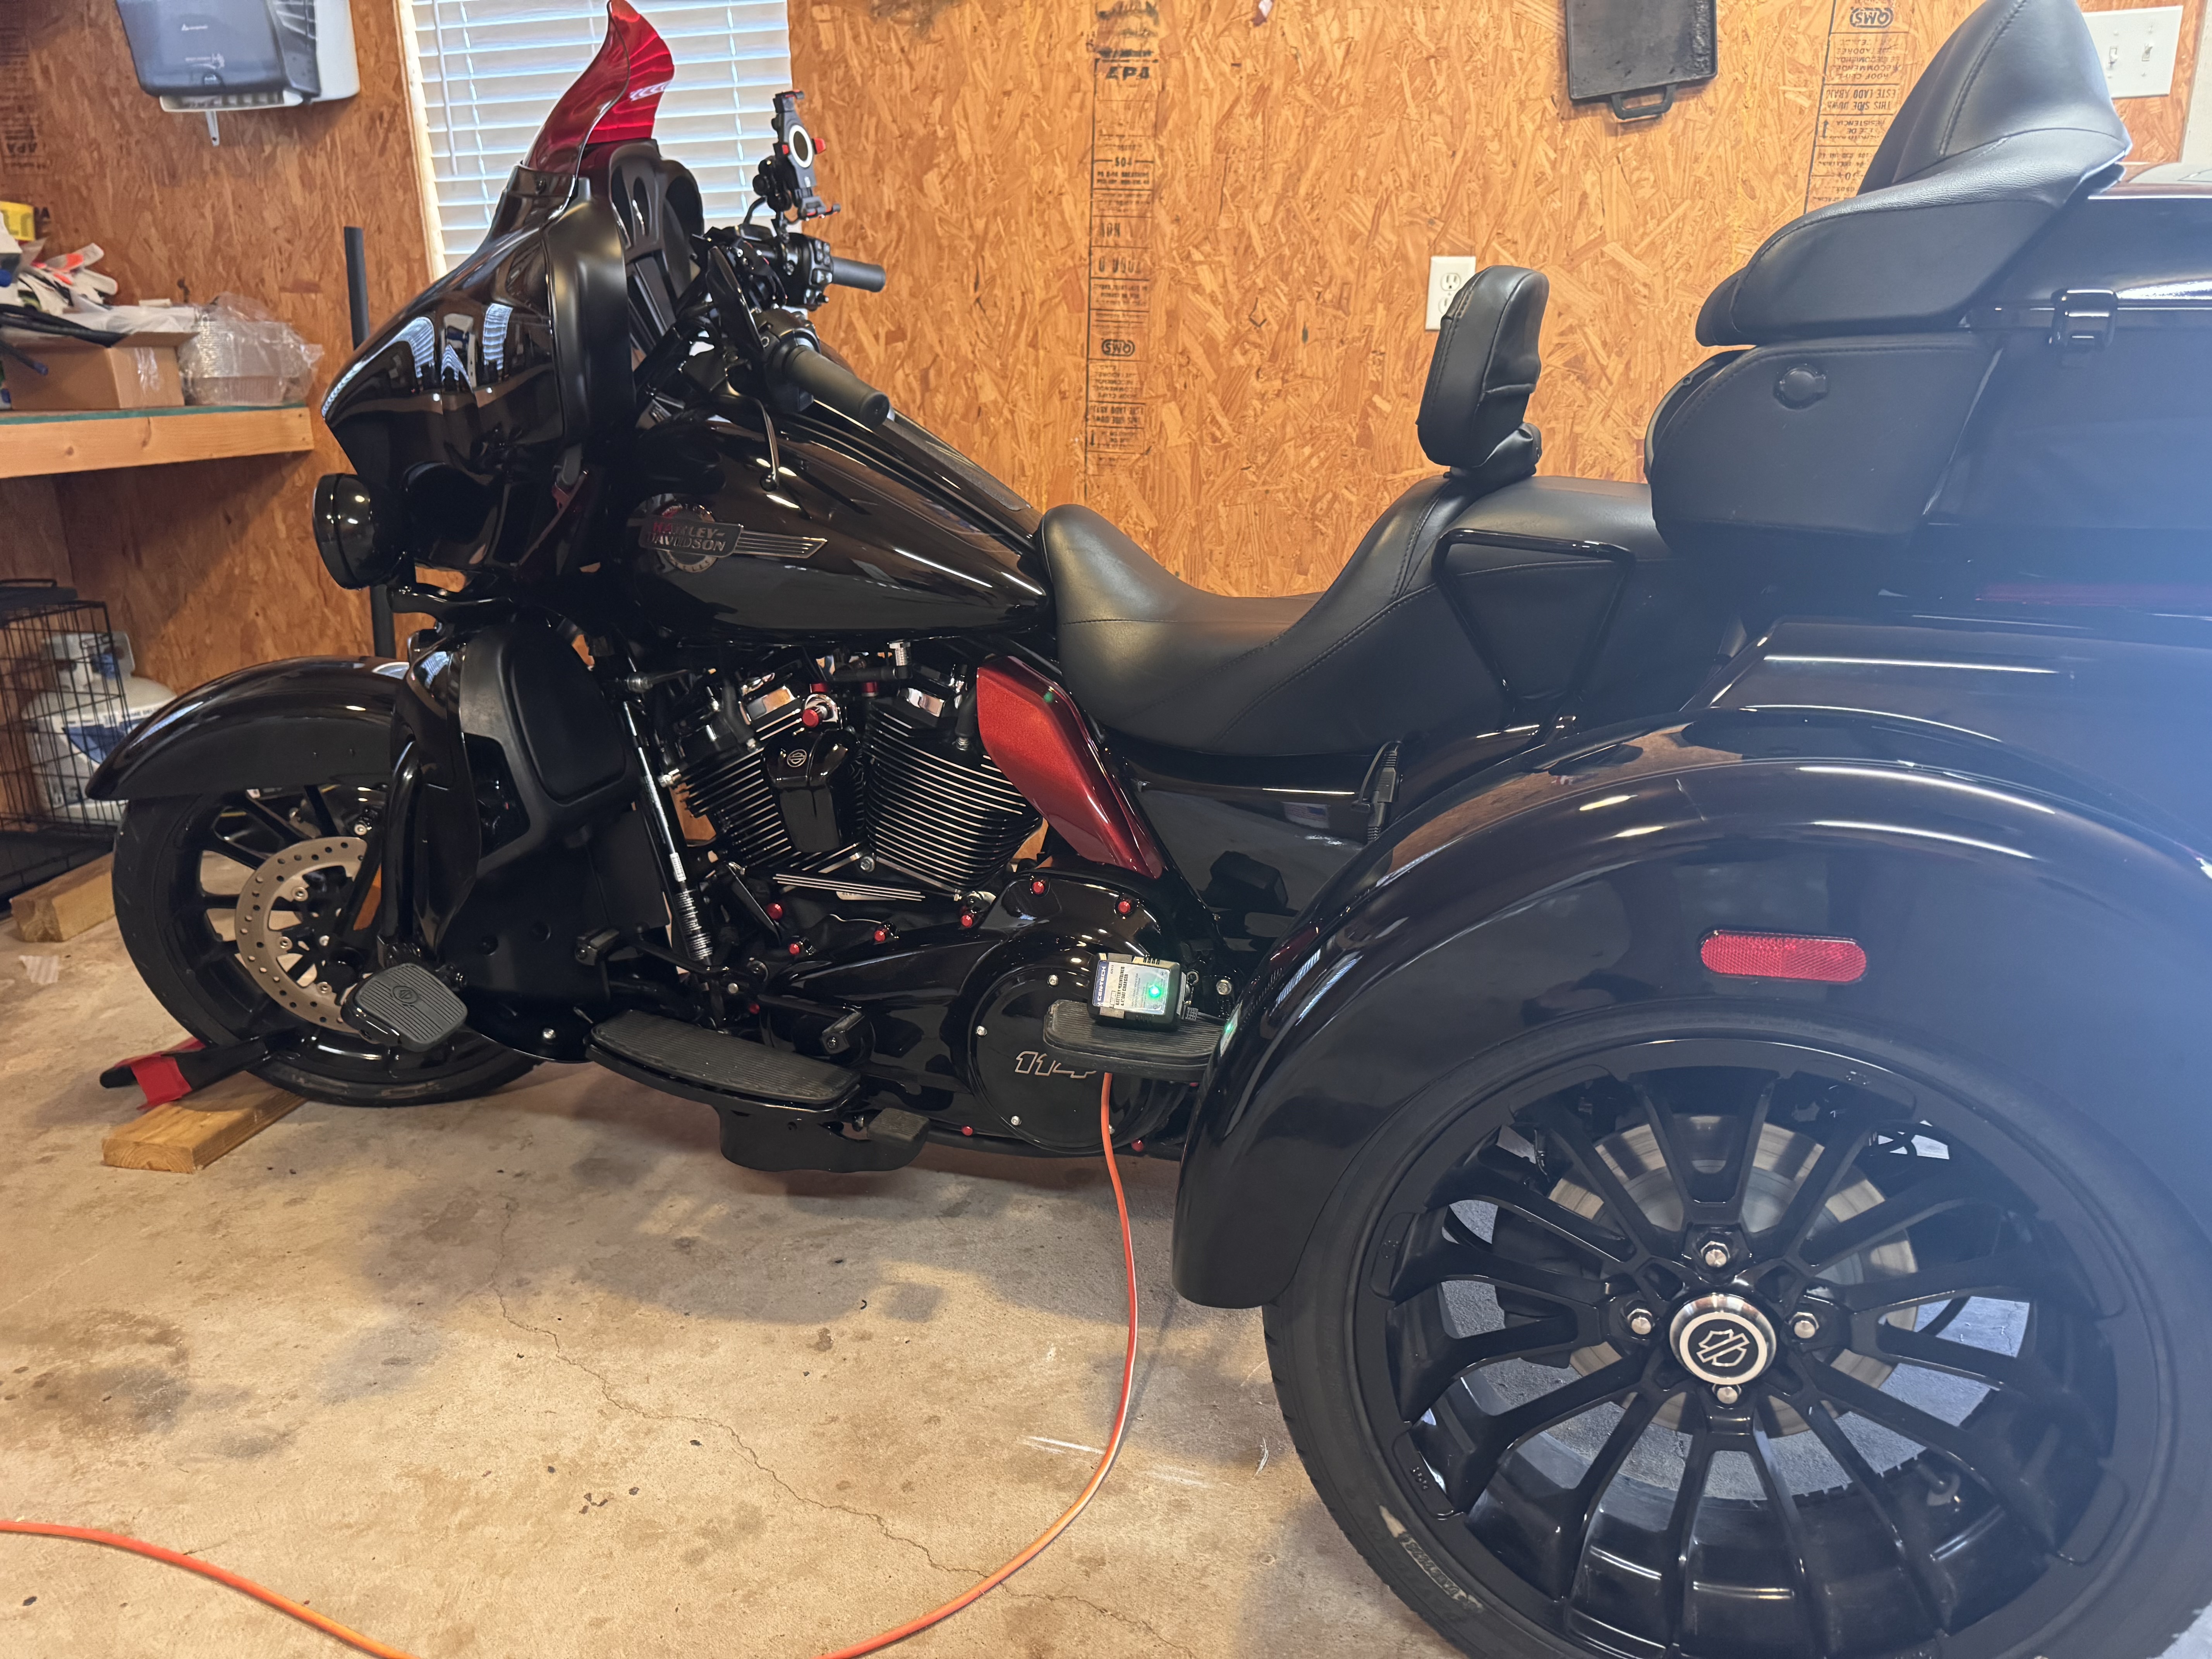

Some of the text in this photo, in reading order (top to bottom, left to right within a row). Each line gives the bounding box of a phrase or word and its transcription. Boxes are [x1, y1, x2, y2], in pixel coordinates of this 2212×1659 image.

[1853, 89, 1873, 99] LADO
[1877, 89, 1896, 98] ESTE
[1853, 101, 1870, 111] SIDE
[1874, 101, 1891, 110] THIS
[647, 532, 726, 552] DAVIDSON
